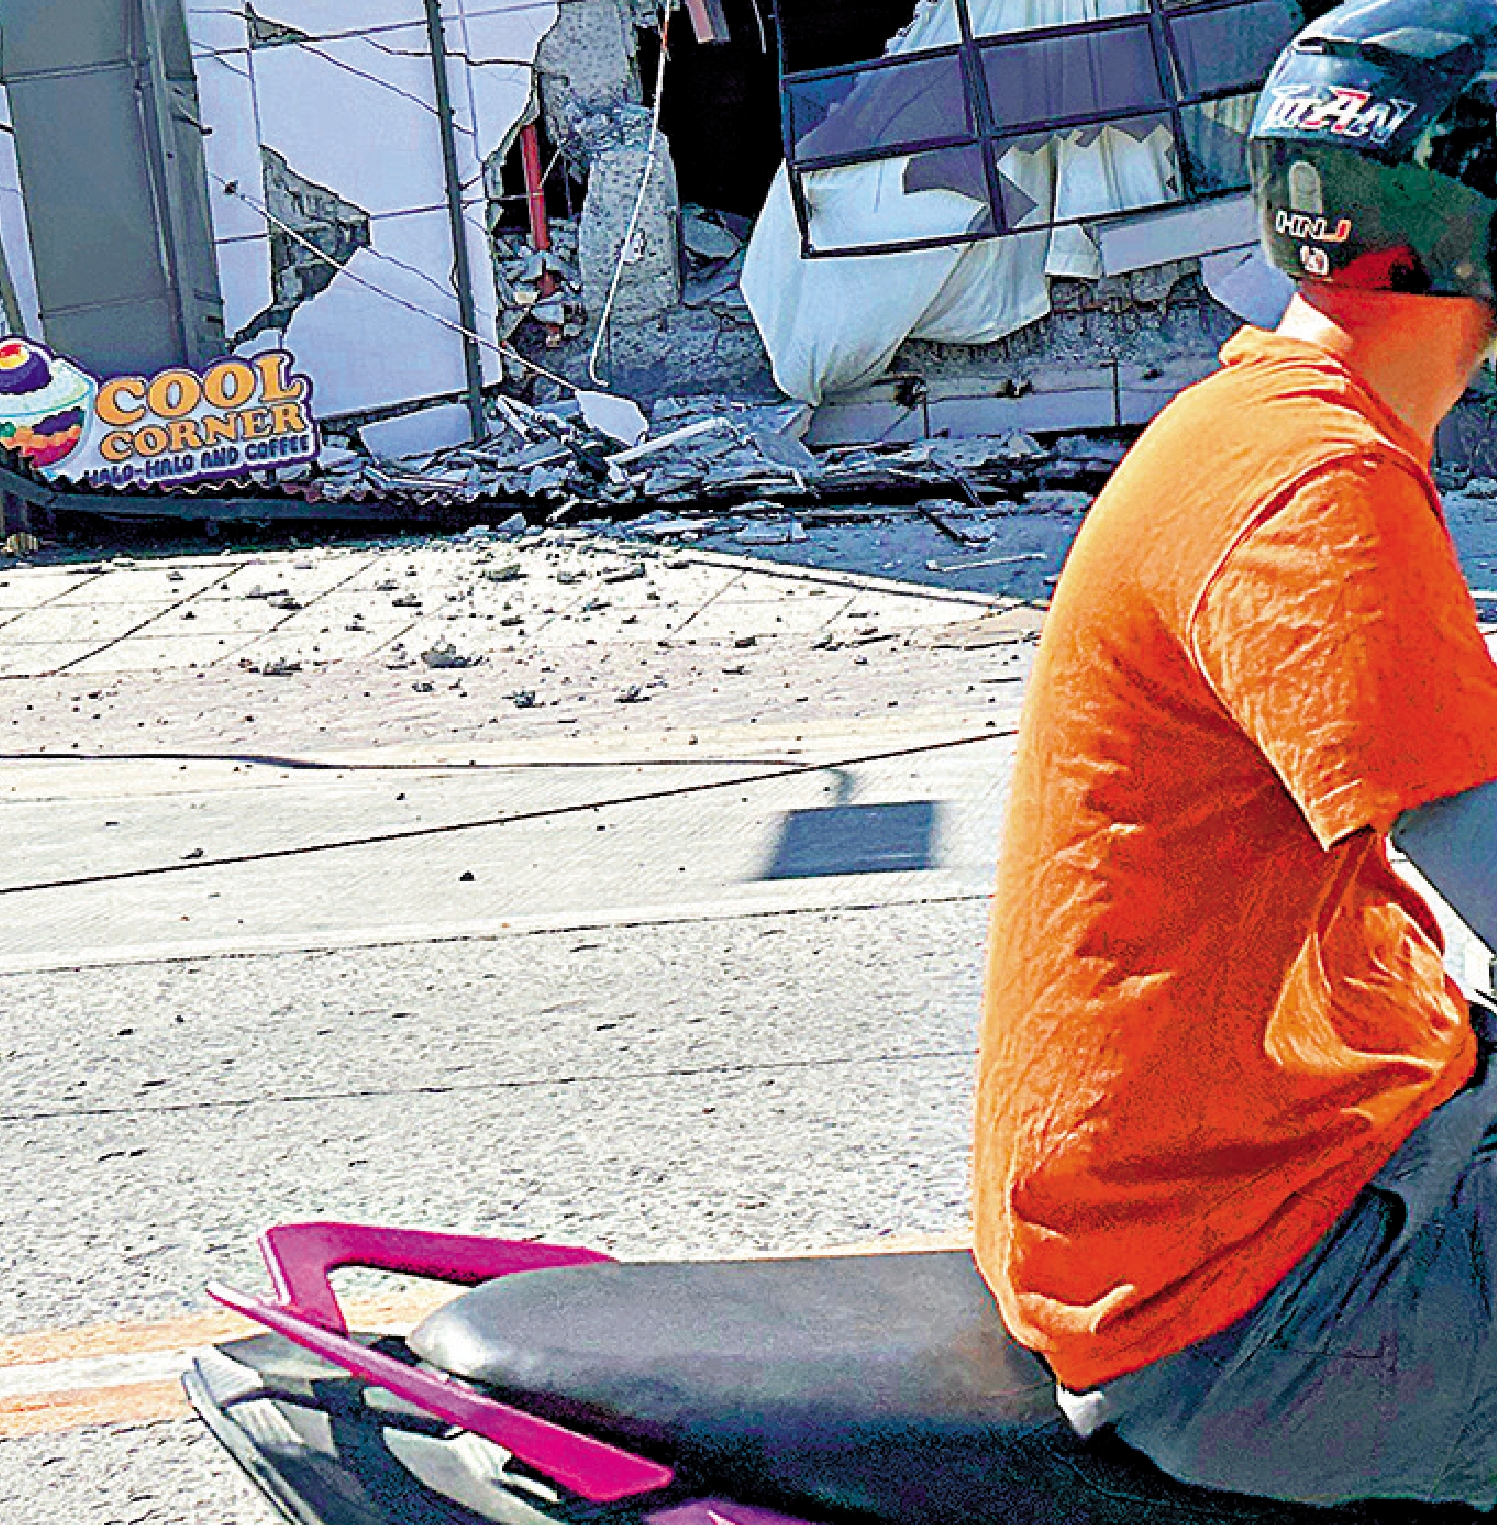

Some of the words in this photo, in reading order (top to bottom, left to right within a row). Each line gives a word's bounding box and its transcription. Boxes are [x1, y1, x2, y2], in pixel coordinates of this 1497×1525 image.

[95, 354, 303, 425] COOL
[101, 403, 305, 461] CORNER
[201, 447, 238, 469] AND
[246, 435, 311, 459] COFFEE
